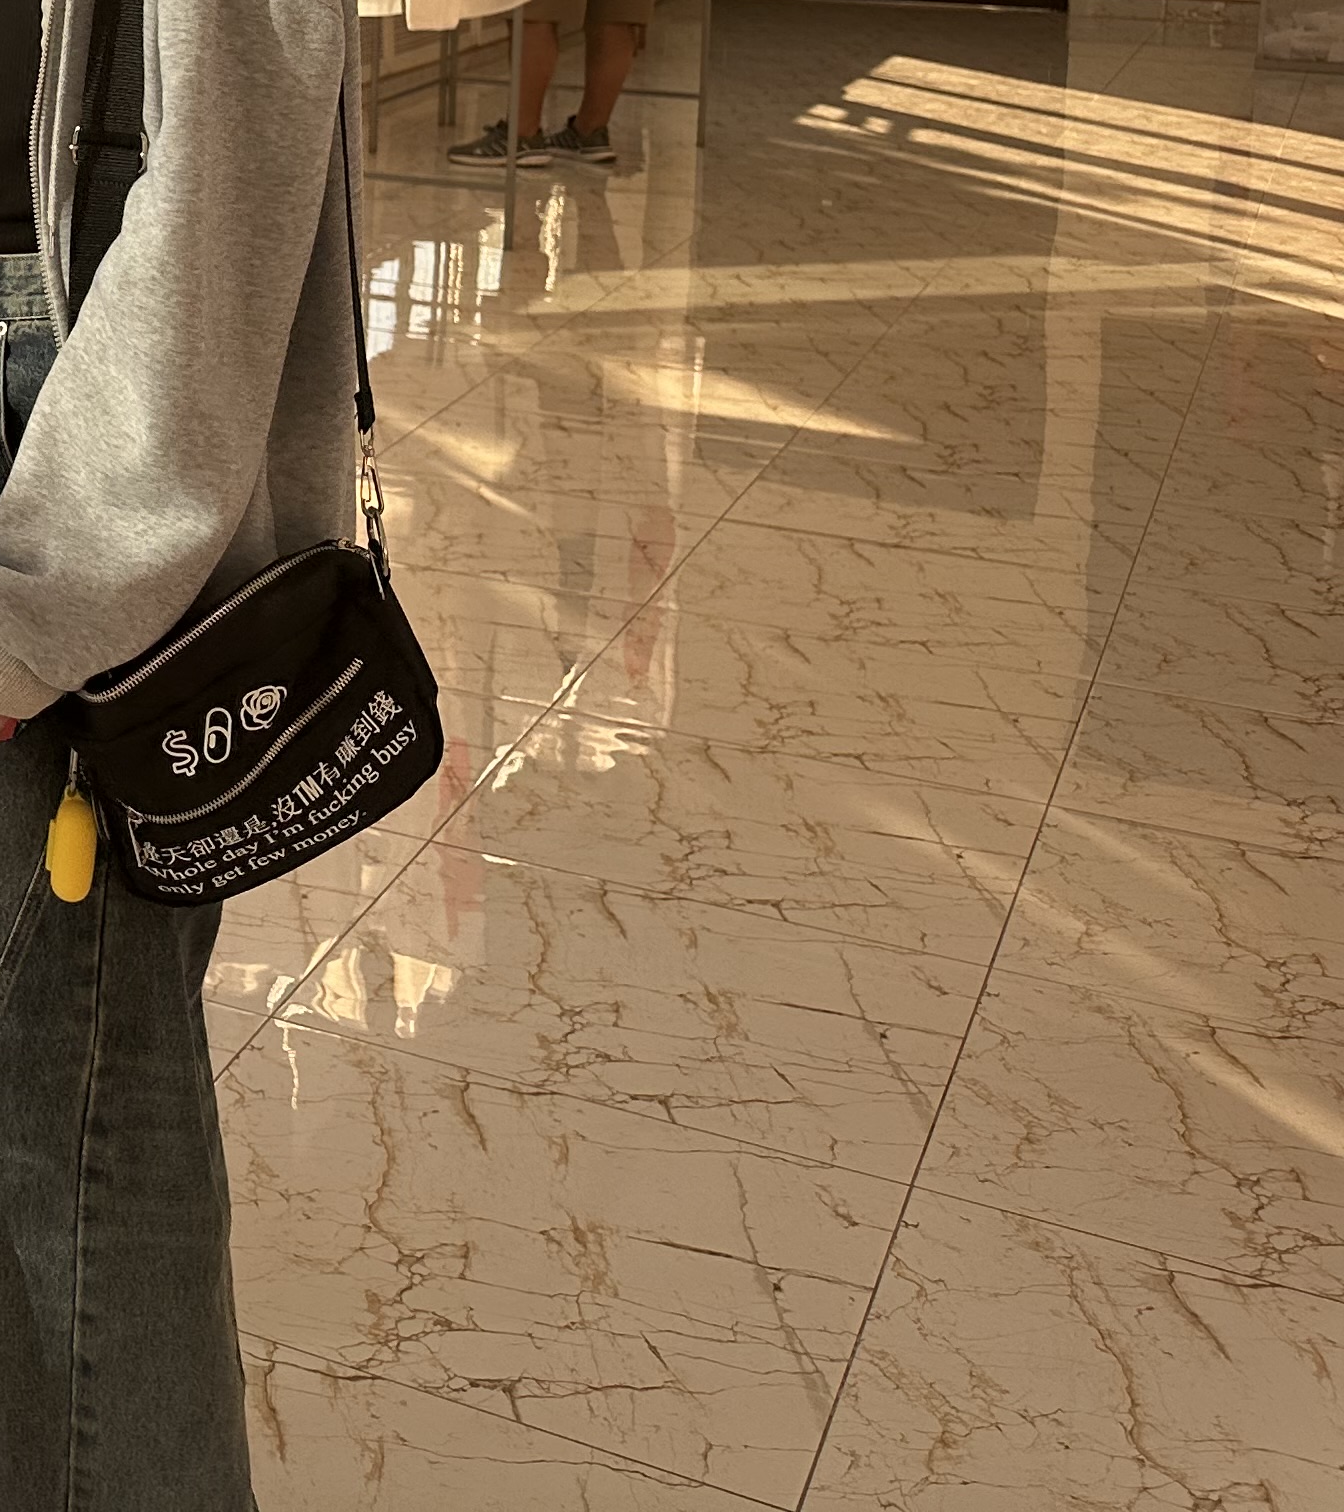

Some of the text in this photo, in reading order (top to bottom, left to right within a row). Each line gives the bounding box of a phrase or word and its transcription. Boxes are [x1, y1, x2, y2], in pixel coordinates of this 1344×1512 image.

[144, 859, 217, 881] Whole
[222, 841, 259, 862] day
[308, 762, 381, 826] fucking
[370, 719, 417, 765] busy
[158, 882, 204, 895] only
[212, 865, 246, 888] get
[248, 848, 285, 871] few
